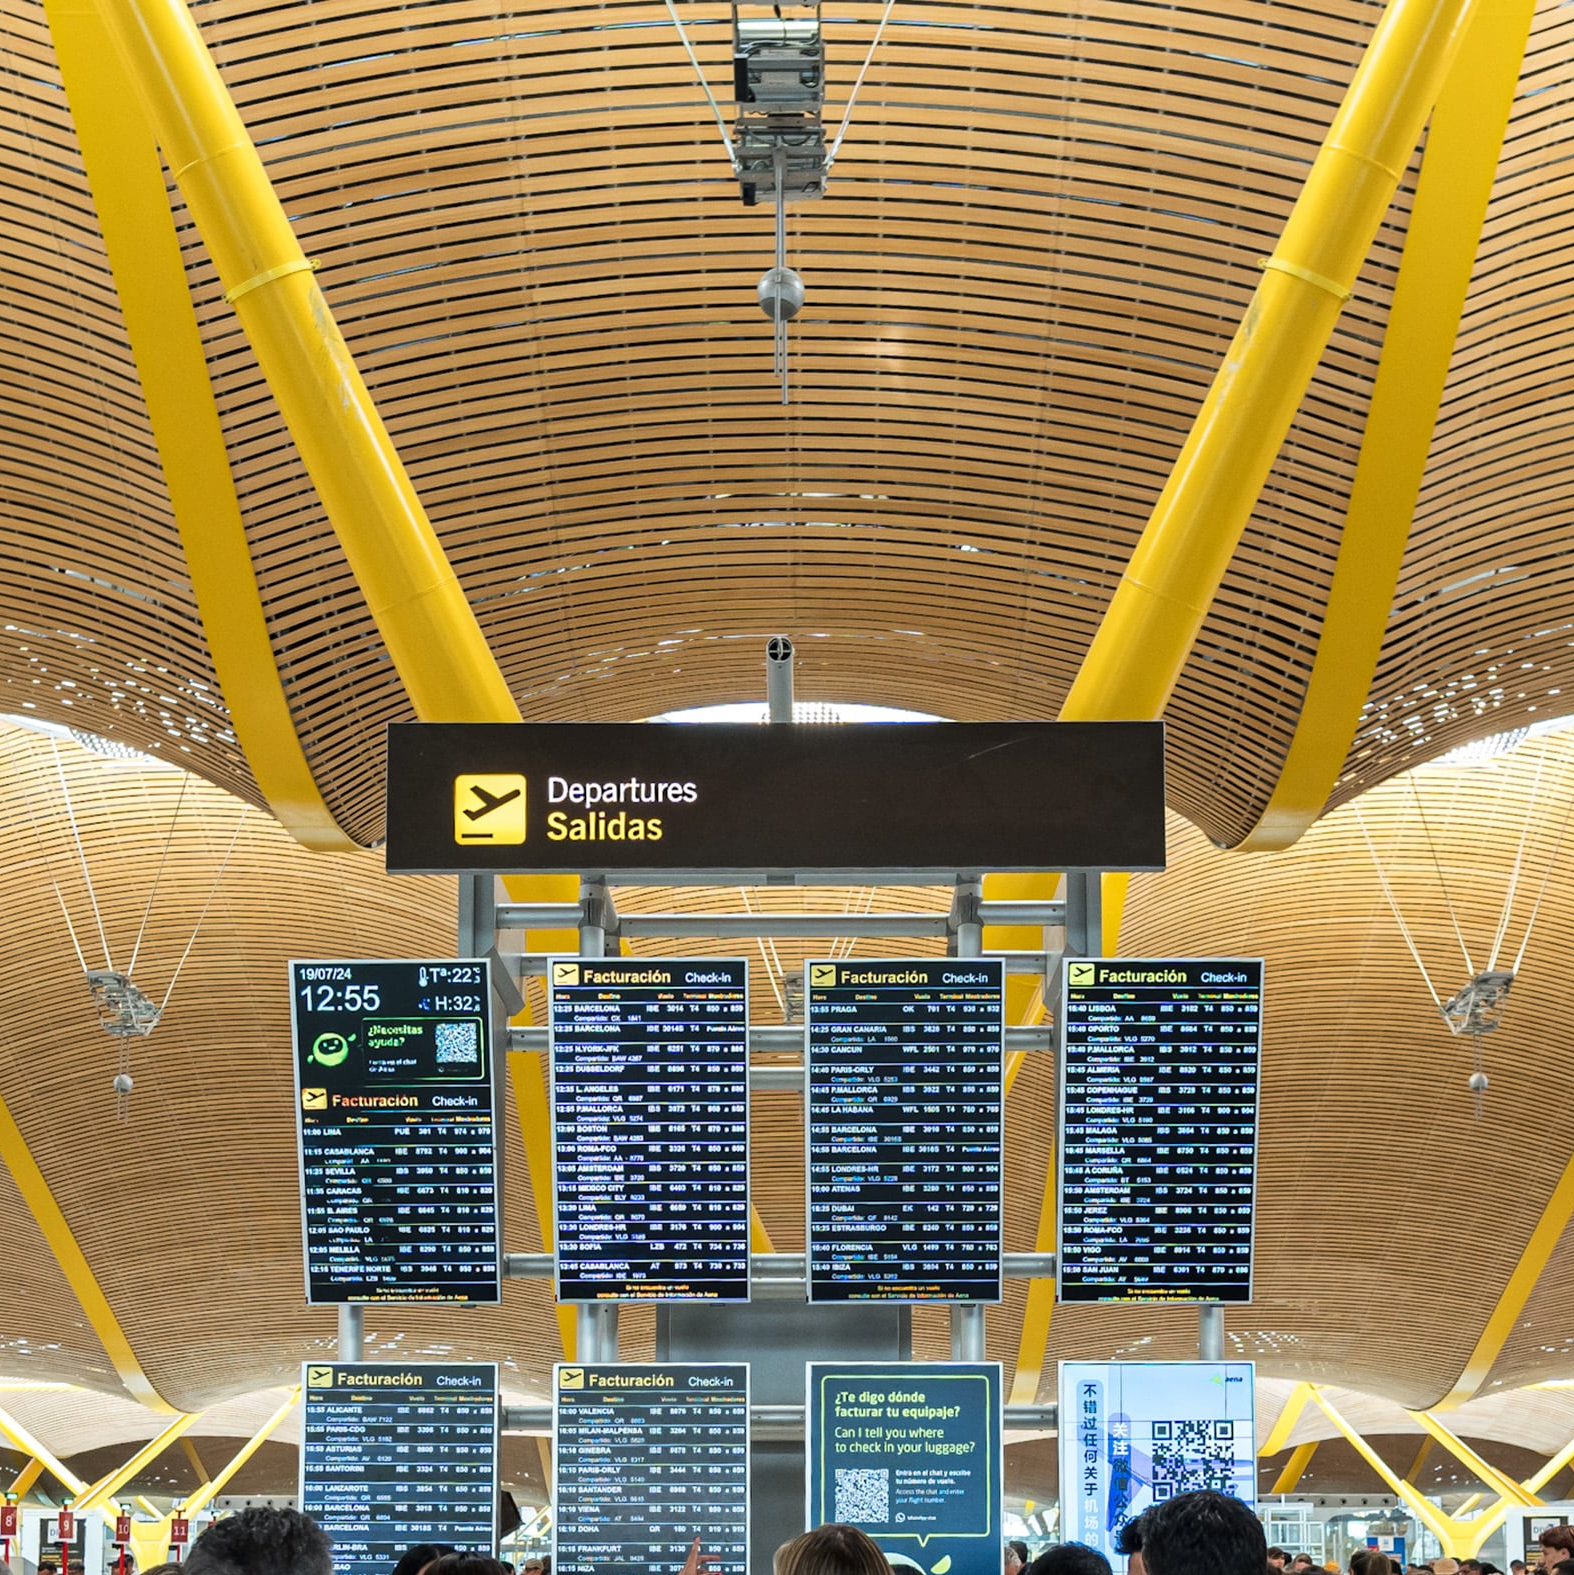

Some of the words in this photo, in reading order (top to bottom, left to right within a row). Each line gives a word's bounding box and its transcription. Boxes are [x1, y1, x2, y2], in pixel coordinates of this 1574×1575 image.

[548, 777, 697, 809] Departures
[547, 811, 662, 840] Salidas
[300, 968, 352, 980] 19/07/24
[584, 970, 671, 983] Facturación
[685, 972, 731, 983] Check-in
[841, 971, 928, 983] Facturación
[942, 973, 988, 983] Check-in
[1100, 969, 1187, 983] Facturación
[1201, 972, 1247, 983] Check-in
[301, 985, 380, 1011] 12:55
[574, 1004, 620, 1013] BARCELONA
[368, 1025, 423, 1036] ¿Necesitas
[574, 1024, 621, 1032] BARCELONA
[831, 1025, 852, 1033] GRAN
[368, 1037, 405, 1049] ayuda?
[332, 1095, 418, 1107] Facturación
[432, 1096, 478, 1106] Check-in
[577, 1124, 608, 1133] BOSTON
[831, 1125, 877, 1133] BARCELONA
[324, 1147, 375, 1155] CASABLANCA
[1085, 1147, 1125, 1155] MARSELLA
[577, 1164, 624, 1172] AMSTERDAM
[831, 1184, 860, 1192] ATENAS
[832, 1204, 854, 1212] DUBAI
[832, 1224, 887, 1232] ESTRASBURGO
[579, 1262, 630, 1270] CASABLANCA
[338, 1373, 422, 1385] Facturación
[436, 1376, 481, 1386] Check-in
[589, 1374, 674, 1386] Facturación
[688, 1376, 733, 1387] Check-in
[1225, 1375, 1243, 1383] aena
[835, 1392, 855, 1404] ¿Te
[859, 1392, 885, 1405] digo
[888, 1391, 925, 1403] dónde
[835, 1406, 883, 1417] facturar
[886, 1407, 899, 1417] tu
[902, 1406, 960, 1420] equipaje?
[835, 1427, 855, 1438] Can
[858, 1428, 862, 1437] I
[865, 1427, 882, 1438] tell
[885, 1429, 906, 1440] you
[909, 1427, 944, 1438] where
[835, 1443, 847, 1453] to
[849, 1442, 881, 1453] check
[884, 1441, 894, 1452] in
[897, 1444, 922, 1455] your
[925, 1441, 975, 1455] luggage?
[1083, 1383, 1098, 1547] 不错过任何关于机场的
[5, 1515, 13, 1527] 8
[63, 1520, 70, 1531] 9
[118, 1524, 129, 1535] 10
[173, 1526, 186, 1537] 11
[578, 1545, 622, 1553] FRANKFURT
